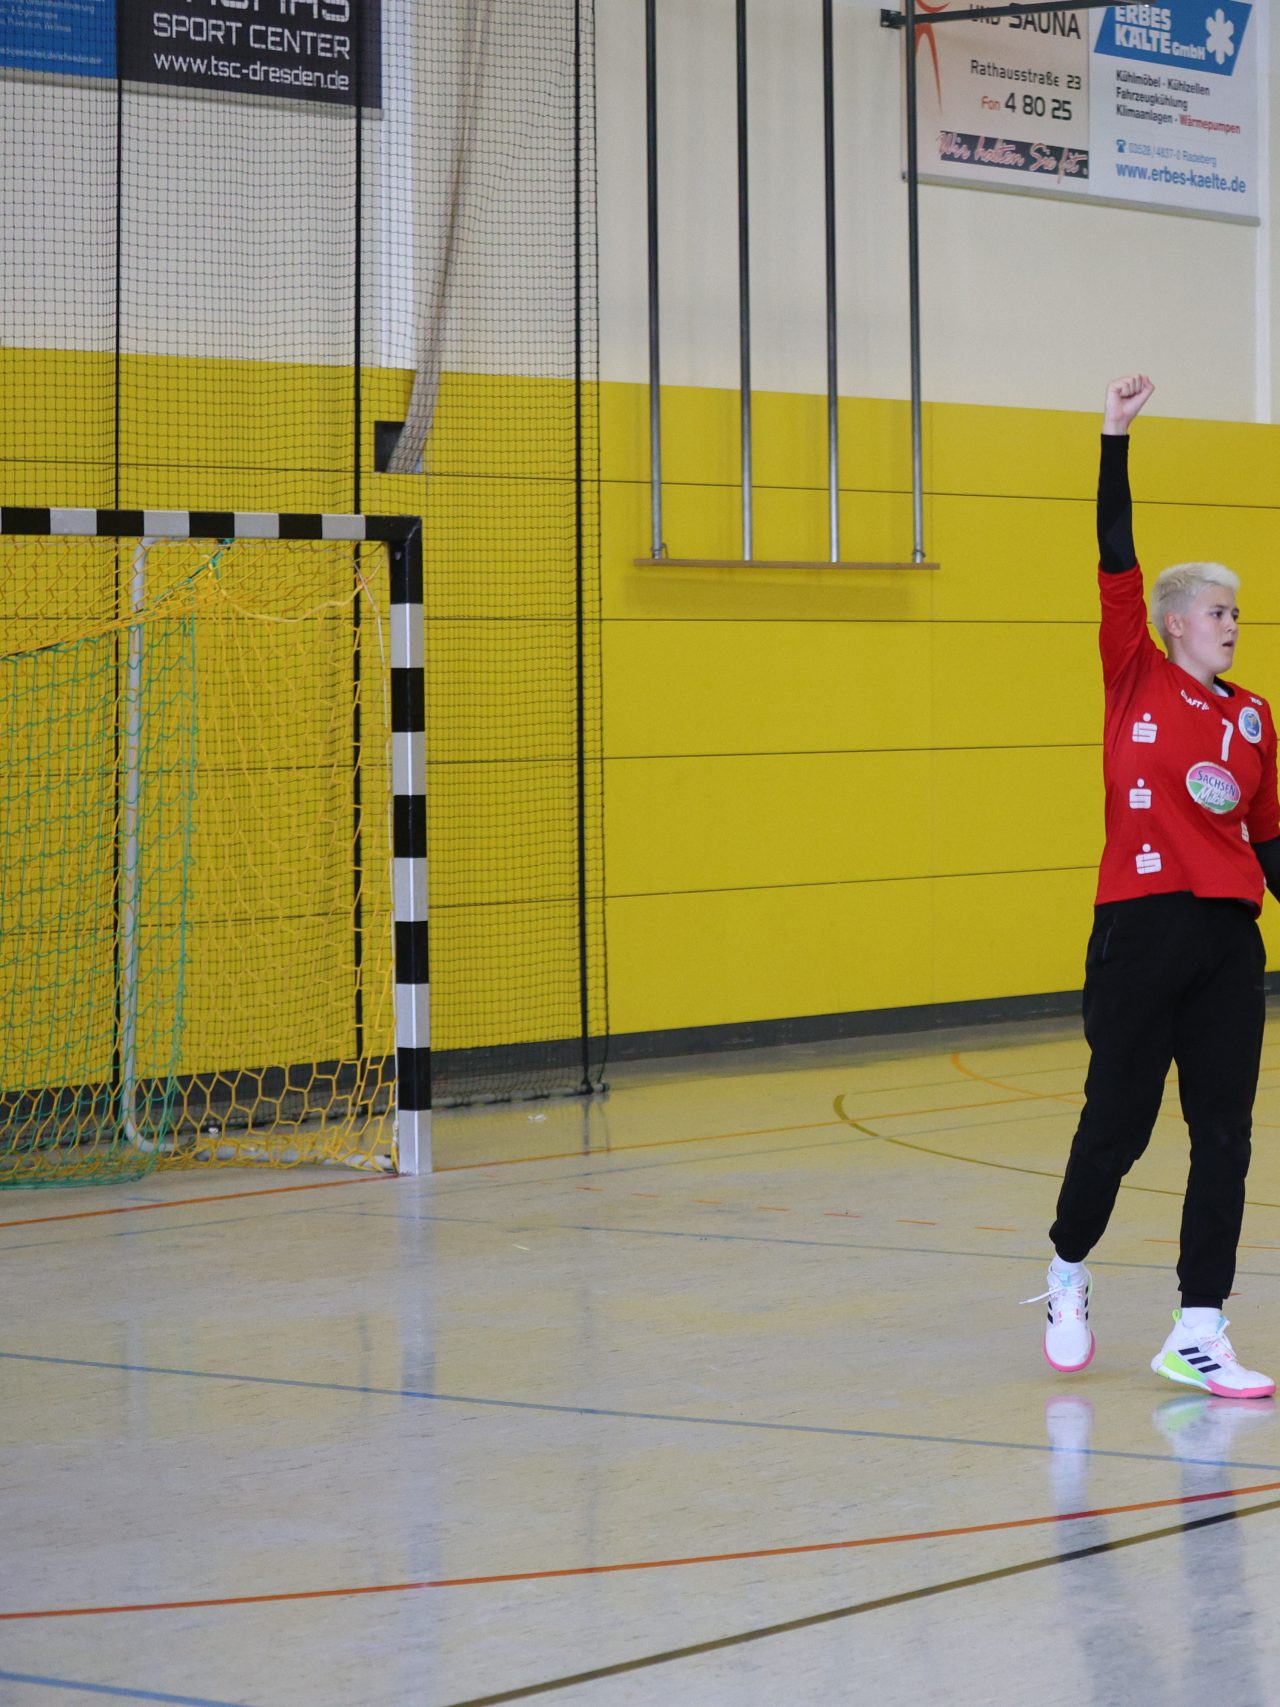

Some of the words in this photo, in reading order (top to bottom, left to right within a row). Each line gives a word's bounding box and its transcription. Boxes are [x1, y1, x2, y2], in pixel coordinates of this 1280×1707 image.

[1009, 11, 1081, 40] SAUNA
[1115, 5, 1172, 31] ERBES
[153, 12, 242, 46] SPORT
[250, 24, 350, 60] CENTER
[1172, 41, 1206, 61] GmbH
[153, 52, 350, 91] www.tsc-dresden.de
[970, 59, 1060, 87] Rathausstraße
[1066, 74, 1082, 90] 23
[1116, 69, 1161, 88] Kühlmöbel
[1167, 78, 1210, 96] Kühlzellen
[1005, 92, 1017, 113] 4
[1022, 94, 1046, 117] 80
[1051, 98, 1073, 121] 25
[1116, 86, 1189, 111] Fahrzeugkühlung
[1116, 104, 1174, 125] Klimaanlagen
[1178, 114, 1241, 135] Wärmepumpen
[1115, 163, 1247, 194] www.erbes-kaelte.de
[1221, 718, 1234, 762] 7
[1197, 769, 1236, 797] SACHSEN
